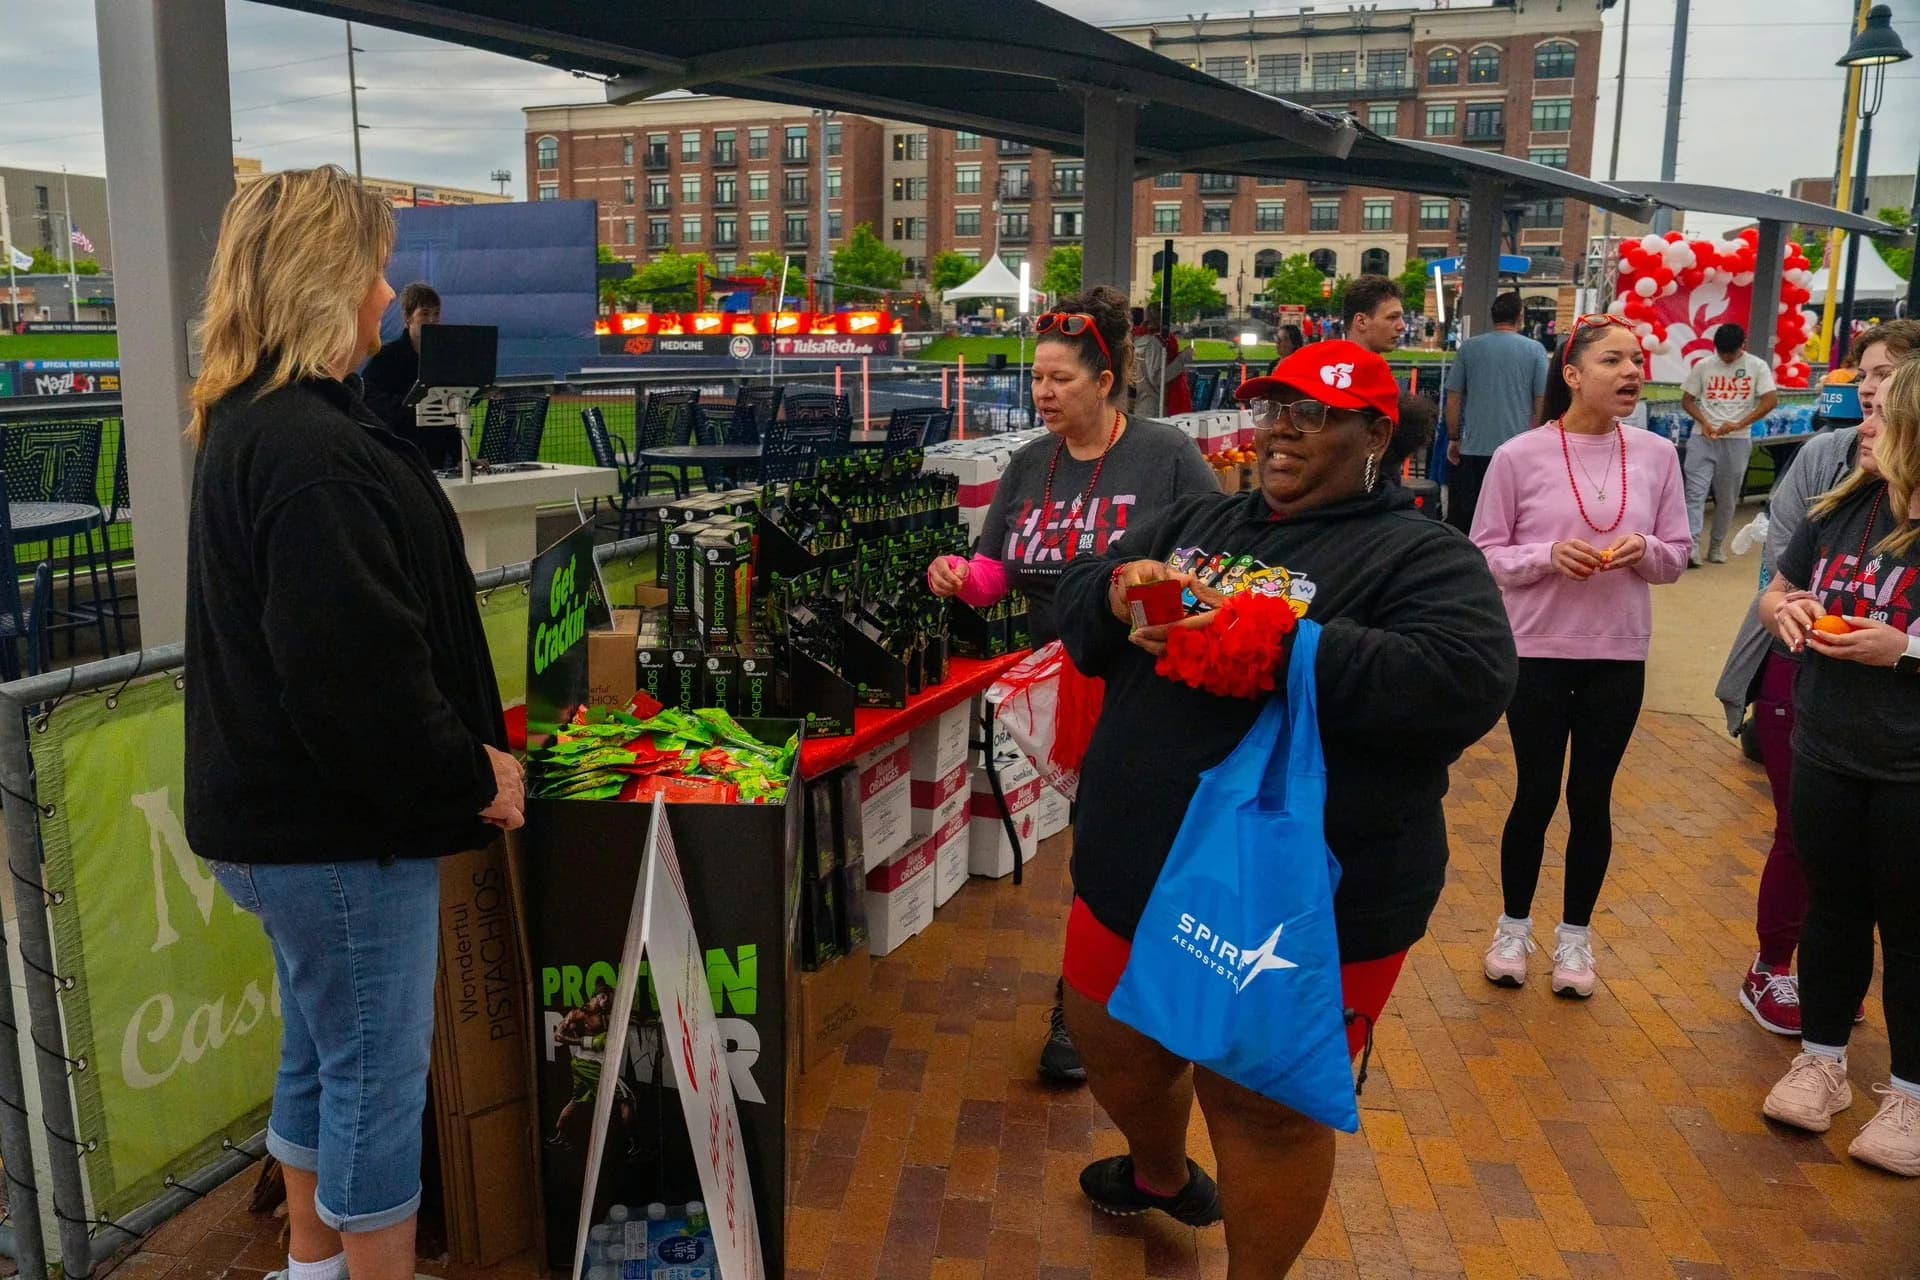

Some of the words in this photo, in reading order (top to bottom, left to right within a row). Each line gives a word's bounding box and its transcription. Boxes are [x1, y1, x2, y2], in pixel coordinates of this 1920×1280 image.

[660, 340, 704, 351] MEDICINE
[793, 337, 873, 354] TulsaTech.edu
[1705, 392, 1751, 400] 24/7
[1706, 375, 1752, 392] NIKE
[1016, 494, 1137, 537] HEART
[550, 552, 577, 618] Get
[675, 550, 686, 606] PISTACHIOS
[714, 567, 725, 627] PISTACHIOS
[534, 591, 589, 675] Crackin'
[590, 683, 609, 693] erful
[869, 766, 899, 794] ORANGES
[900, 857, 927, 882] ORANGES
[455, 902, 480, 1024] Wonderful
[472, 867, 515, 1041] PISTACHIOS
[1171, 934, 1239, 988] AEROSYSTE
[1177, 912, 1243, 971] SPIR
[672, 1240, 685, 1259] Life
